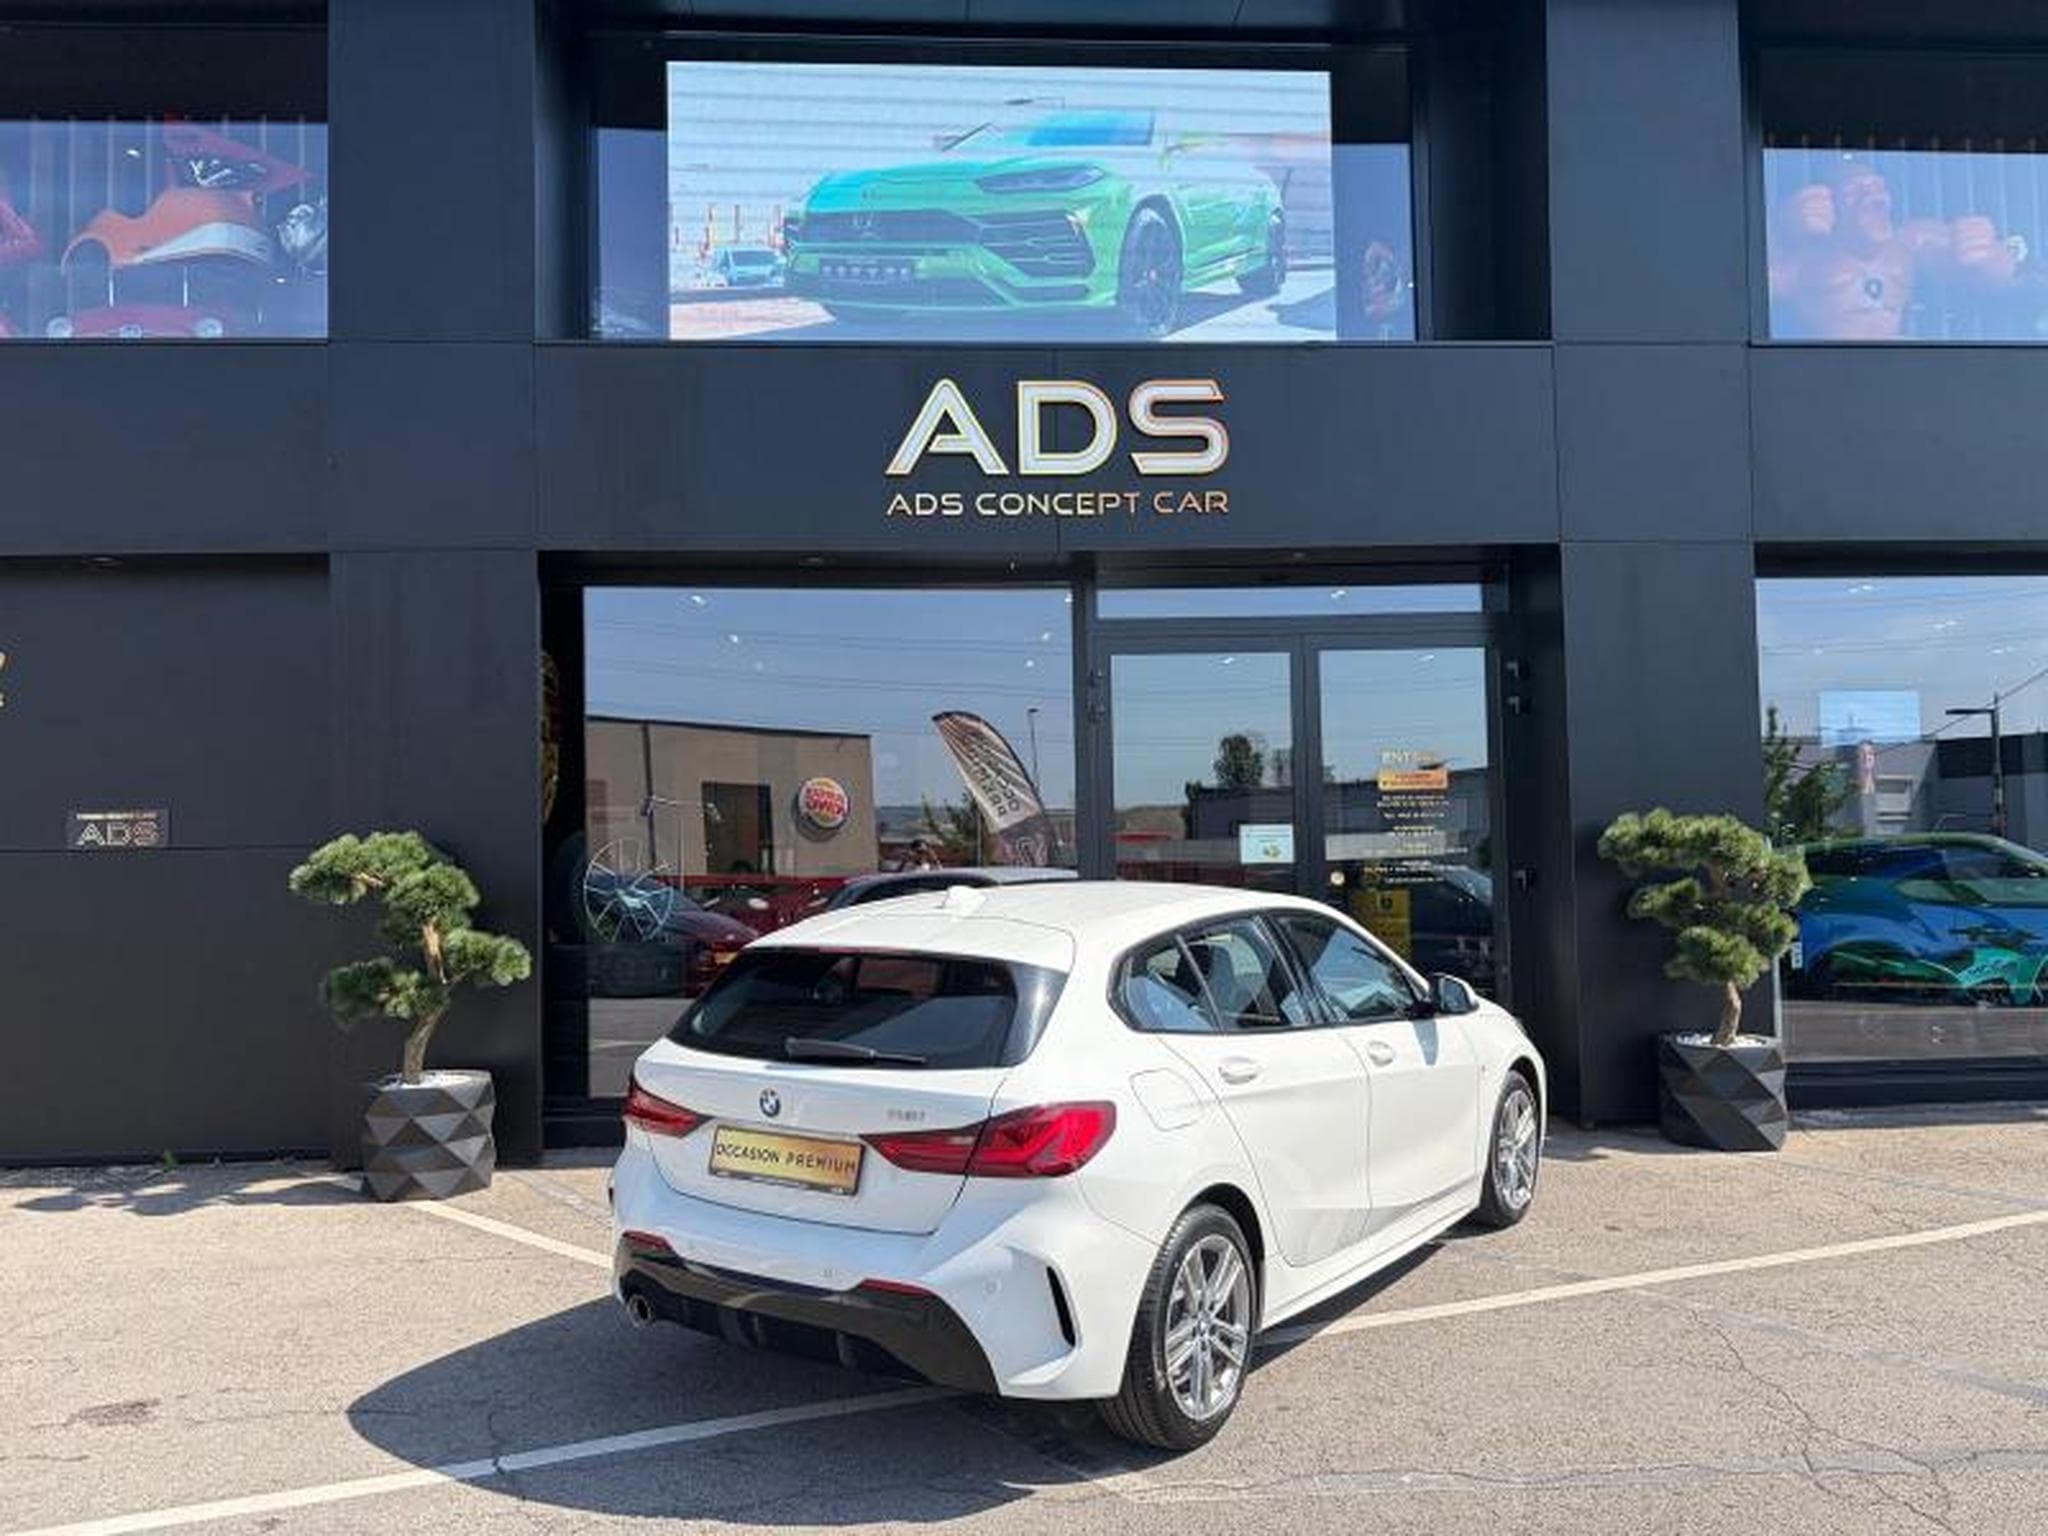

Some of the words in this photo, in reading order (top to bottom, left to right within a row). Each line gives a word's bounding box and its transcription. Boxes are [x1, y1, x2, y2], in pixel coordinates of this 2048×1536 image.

[885, 378, 1230, 475] ADS
[886, 493, 964, 516] ADS
[975, 492, 1140, 516] CONCEPT
[1153, 491, 1230, 515] CAR
[75, 821, 160, 846] ADS
[715, 1143, 780, 1164] OCCASION
[785, 1151, 856, 1174] PREMIUM
